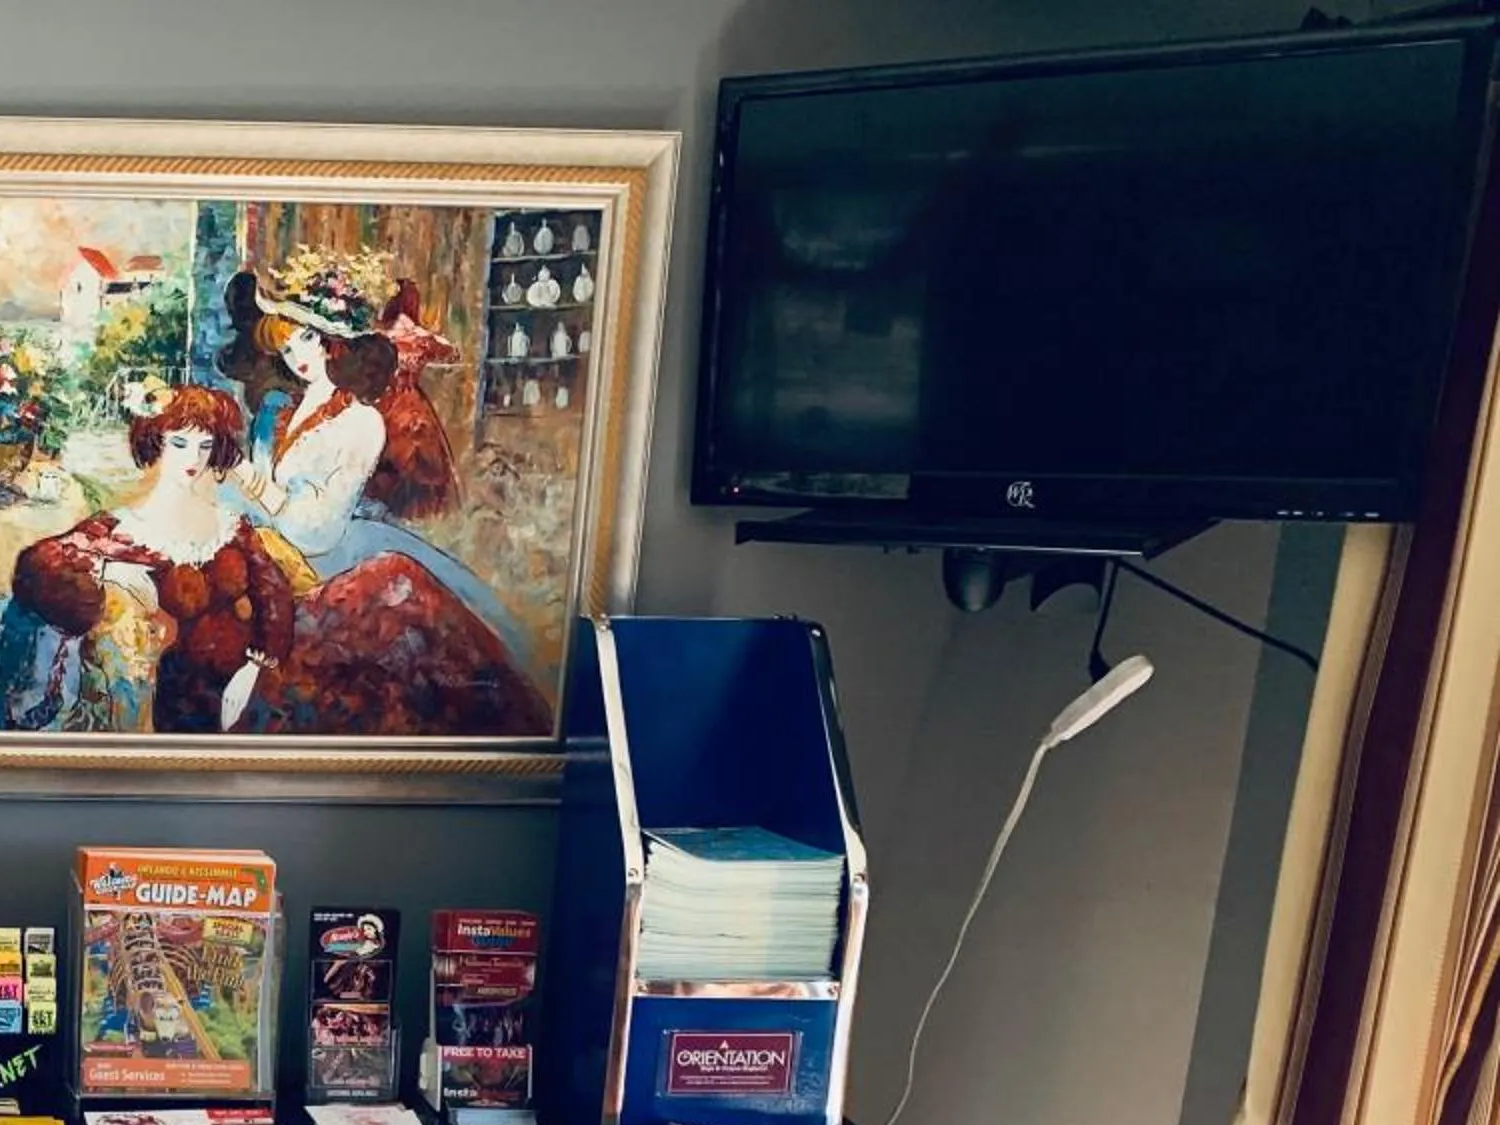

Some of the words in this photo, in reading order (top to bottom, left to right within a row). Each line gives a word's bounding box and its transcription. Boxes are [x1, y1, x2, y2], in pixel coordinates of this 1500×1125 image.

[135, 883, 258, 907] GUIDE-MAP
[444, 1047, 474, 1057] FREE
[476, 1047, 493, 1058] TO
[494, 1047, 526, 1059] TAKE
[677, 1050, 785, 1067] ORIENTATION
[89, 1068, 119, 1081] Guest
[121, 1069, 165, 1082] Services
